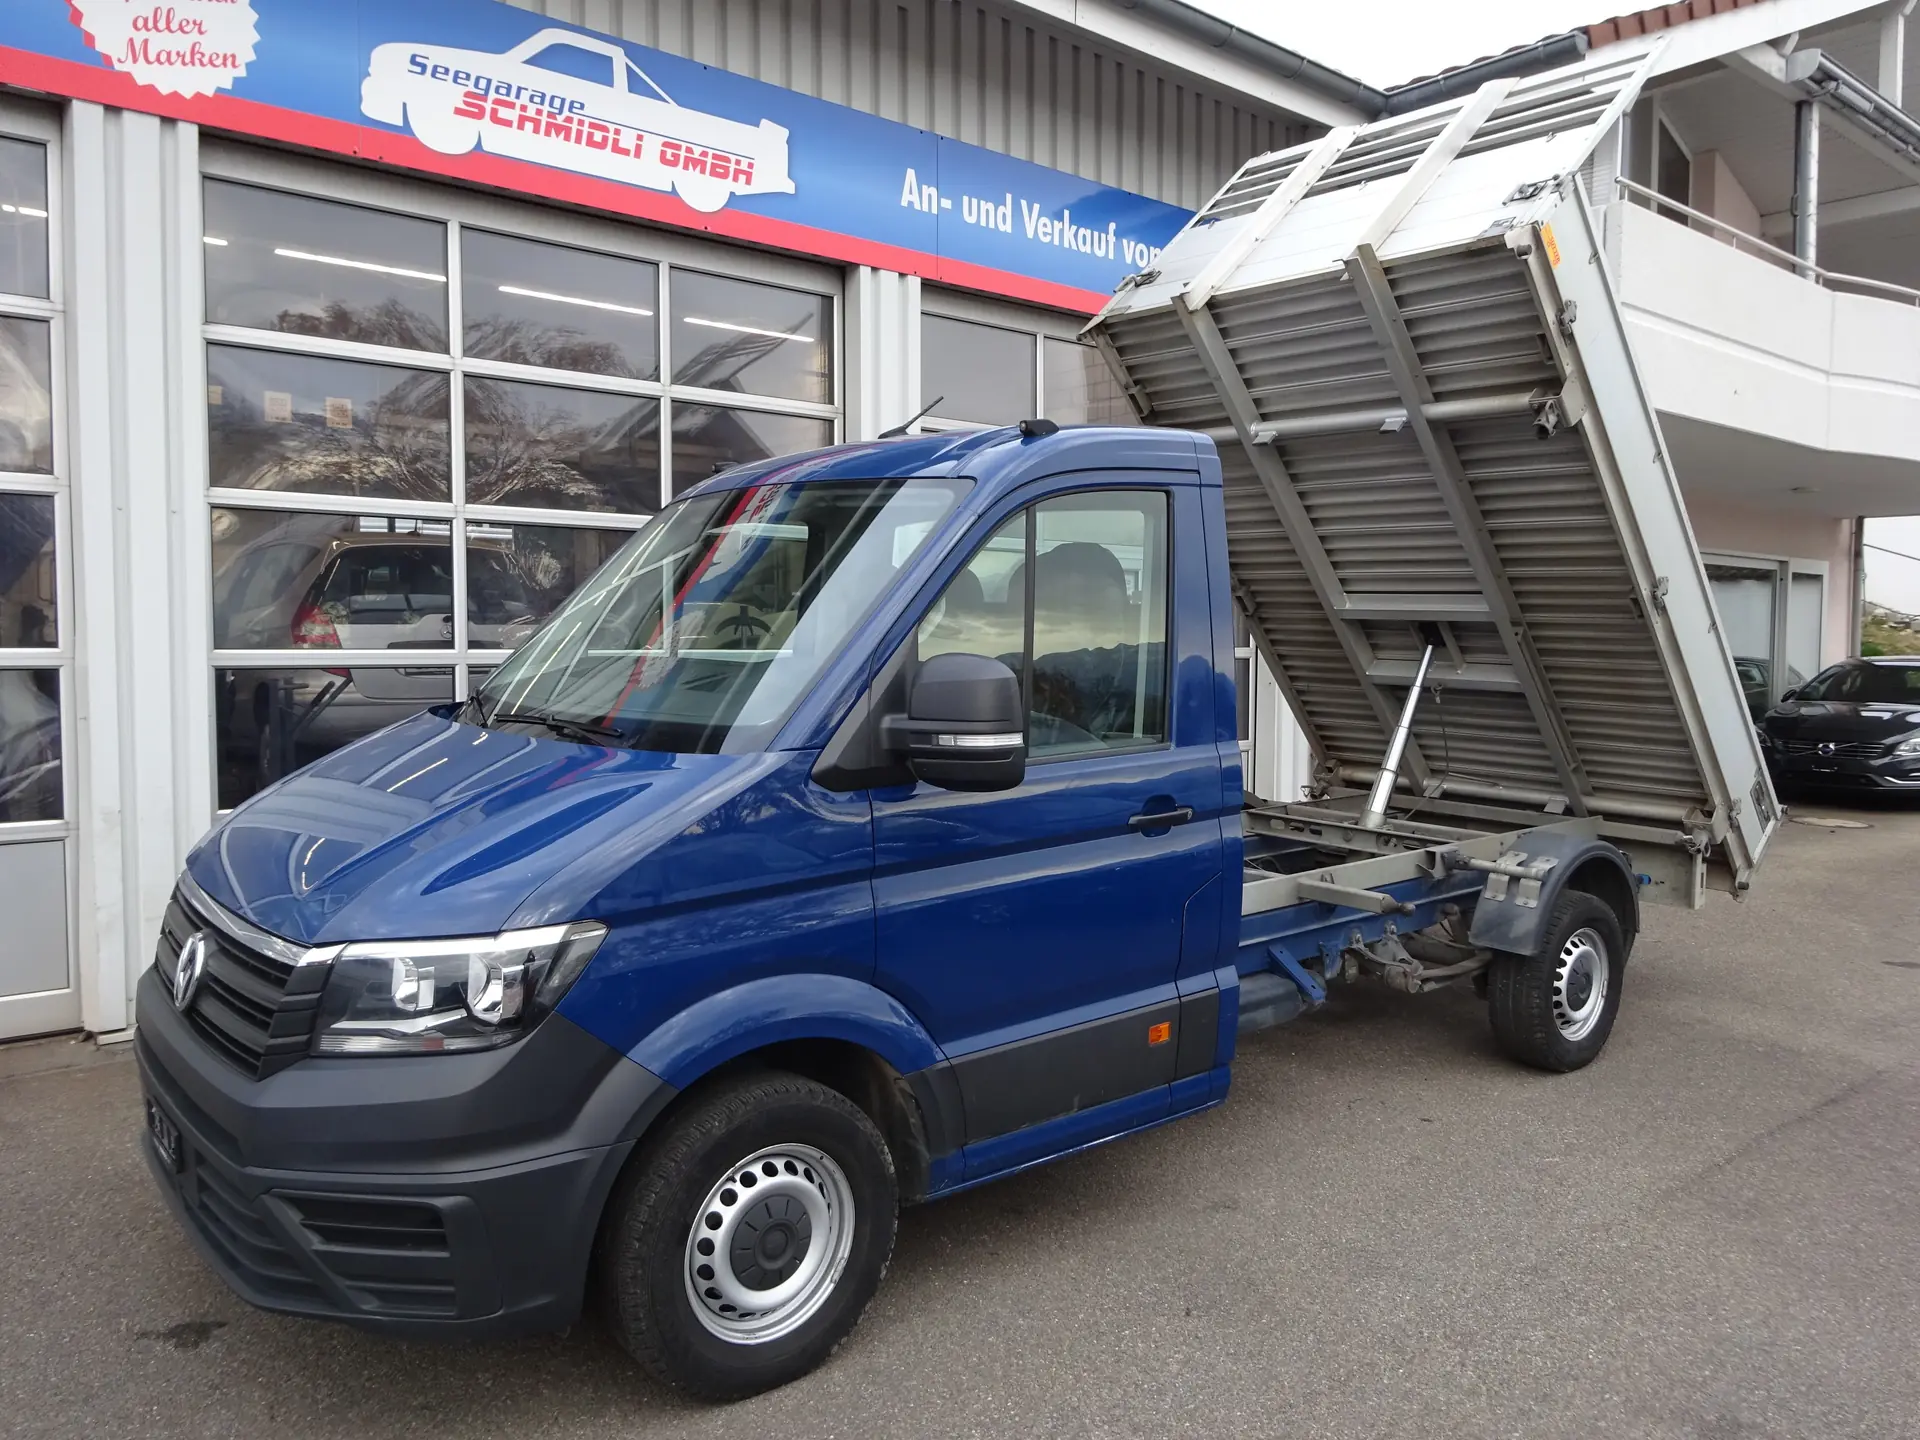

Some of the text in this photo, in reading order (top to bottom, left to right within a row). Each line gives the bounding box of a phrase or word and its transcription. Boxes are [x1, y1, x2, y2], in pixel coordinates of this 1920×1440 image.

[132, 6, 208, 35] aller
[117, 37, 240, 69] Marken
[408, 53, 586, 116] Seegarage
[900, 168, 952, 215] An-
[962, 193, 1012, 234] und
[1020, 199, 1117, 260] Verkauf
